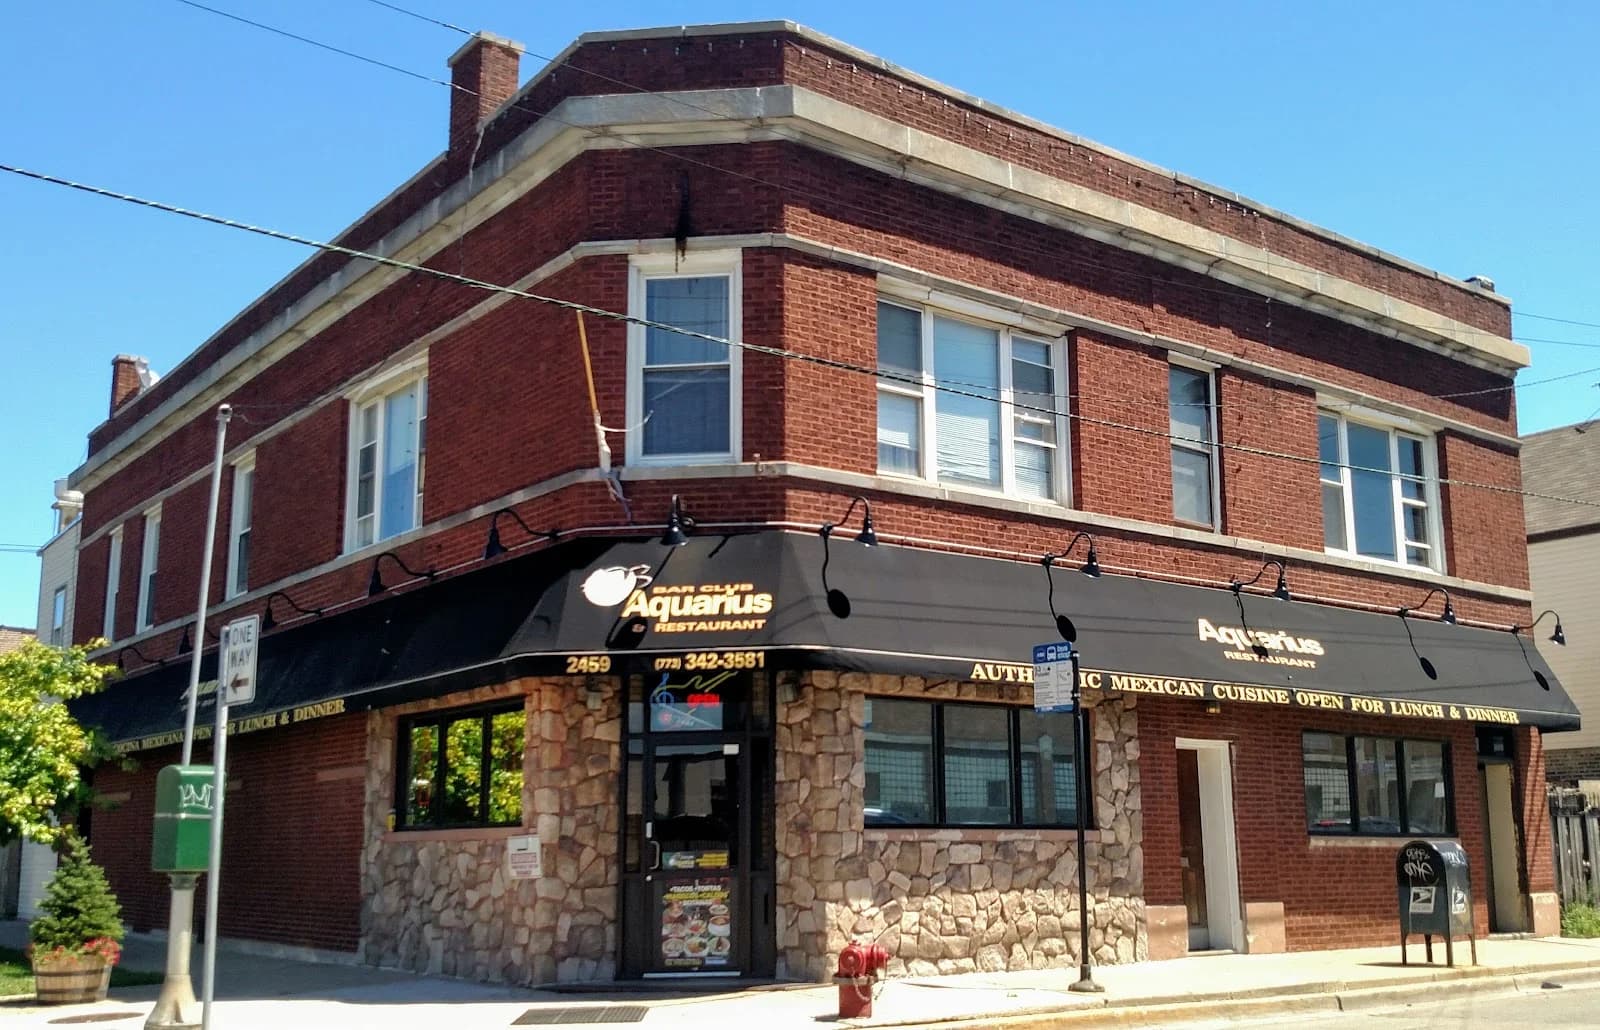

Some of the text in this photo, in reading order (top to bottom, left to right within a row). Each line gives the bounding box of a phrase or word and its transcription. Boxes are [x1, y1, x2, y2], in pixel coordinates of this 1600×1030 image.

[653, 583, 754, 594] BAR CLUB
[621, 588, 773, 623] Aquarius
[231, 625, 252, 646] ONE
[654, 620, 766, 632] RESTAURANT
[1198, 618, 1325, 656] Aquarius
[230, 647, 253, 668] WAY
[566, 655, 612, 674] 2459
[654, 651, 765, 671] (773) 342-3581
[970, 662, 1102, 689] AUTHIC
[1111, 674, 1205, 697] MEXICAN
[1212, 684, 1290, 704] CUISINE
[1296, 691, 1345, 710] OPEN
[1351, 698, 1386, 714] FOR
[1391, 701, 1444, 719] LUNCH
[1450, 705, 1461, 719] &
[1466, 707, 1520, 725] DINNER
[141, 731, 184, 750] MEXICANA
[193, 726, 213, 740] PEN
[238, 714, 277, 734] LUNCH
[280, 711, 290, 726] &
[294, 699, 345, 722] DINNER
